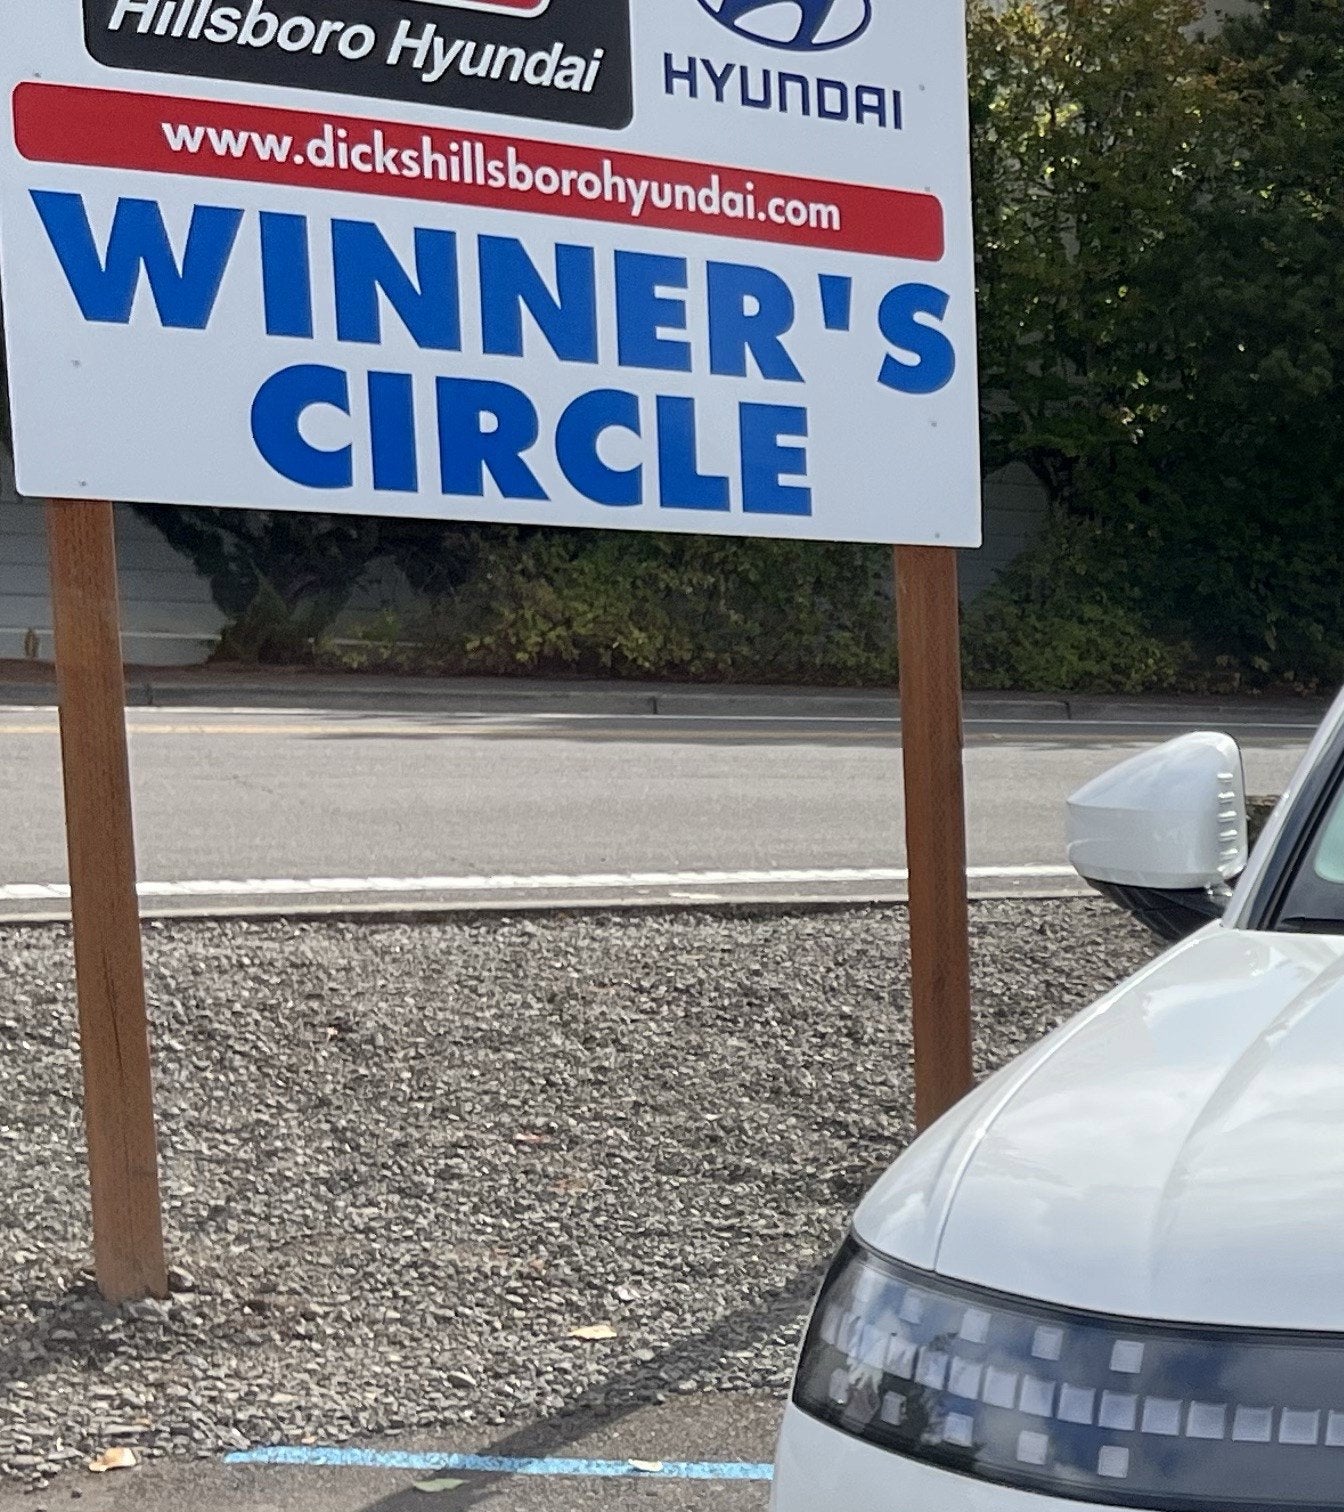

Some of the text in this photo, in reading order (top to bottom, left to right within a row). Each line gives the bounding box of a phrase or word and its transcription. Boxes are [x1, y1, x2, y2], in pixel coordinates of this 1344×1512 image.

[387, 19, 604, 93] Hyundai
[663, 52, 902, 130] HYUNDAI
[161, 120, 841, 231] www.dickshillsborohyundai.com
[28, 188, 956, 394] WINNER'S
[250, 363, 813, 517] CIRCLE
